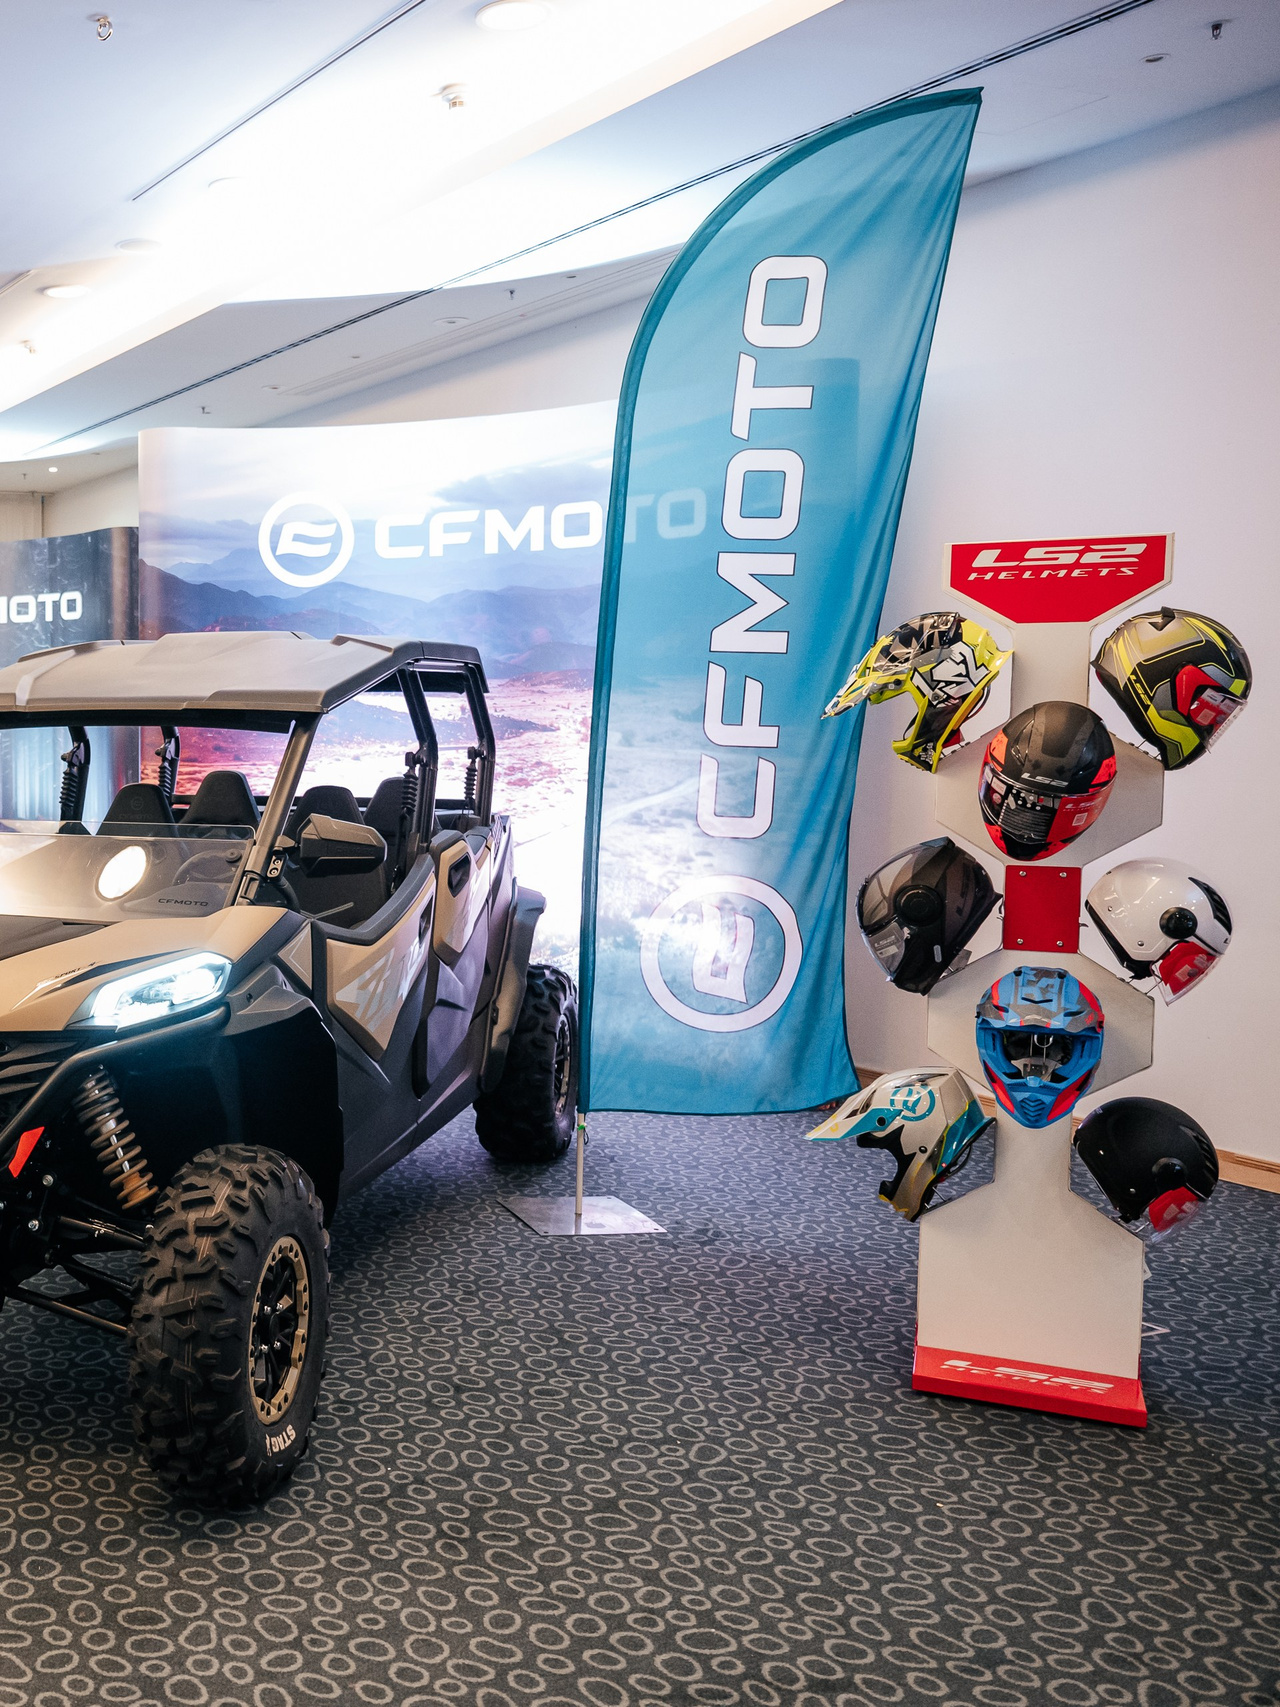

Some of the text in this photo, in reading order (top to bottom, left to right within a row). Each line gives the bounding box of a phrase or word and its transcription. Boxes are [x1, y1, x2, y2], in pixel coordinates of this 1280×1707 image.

[696, 255, 829, 840] CFMOTO
[971, 543, 1147, 568] LS2
[967, 566, 1139, 581] HELMETS
[1021, 772, 1069, 788] LS2
[158, 897, 209, 908] CFMOTO
[943, 1359, 1115, 1389] LS2
